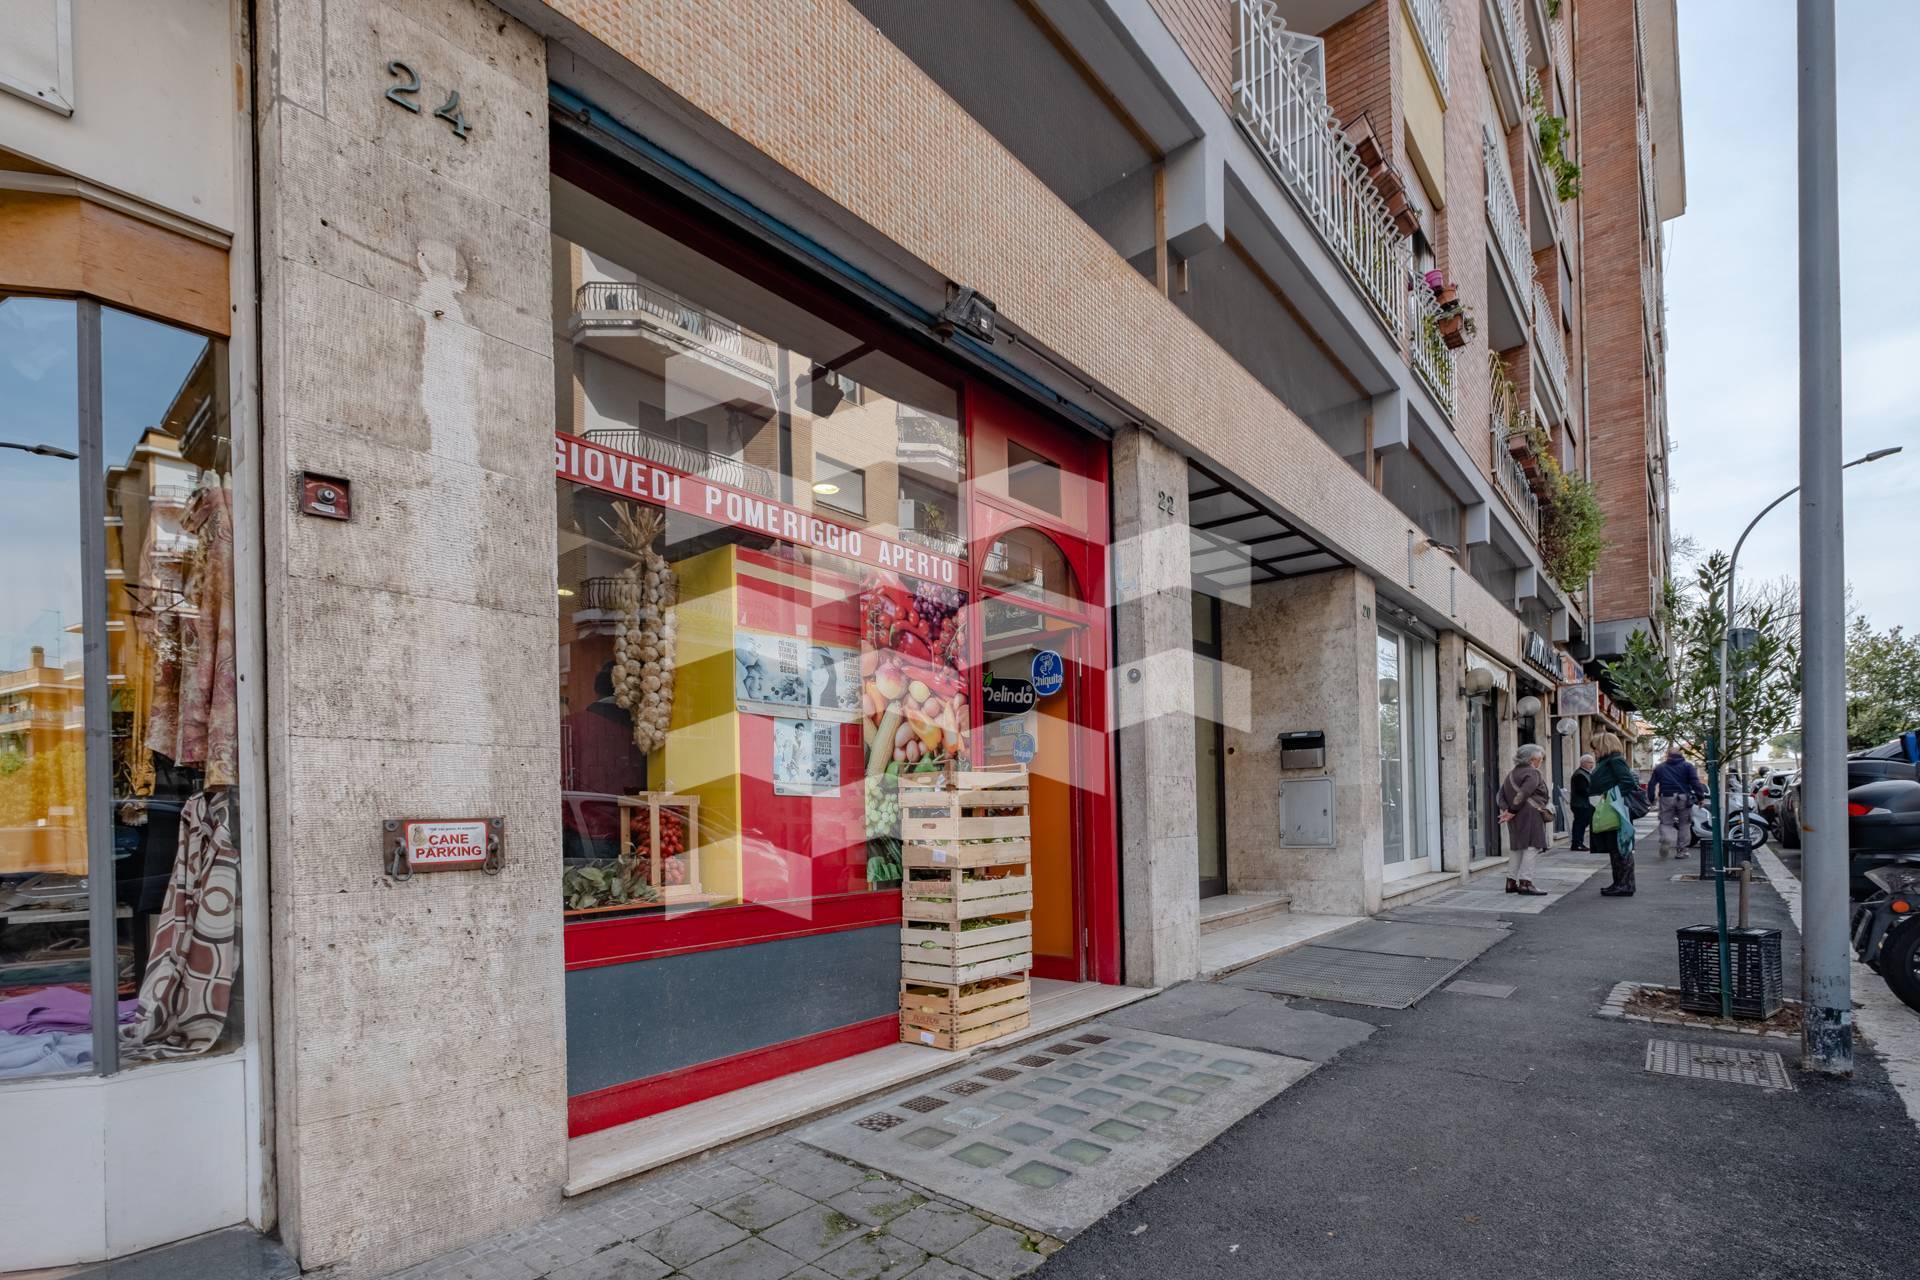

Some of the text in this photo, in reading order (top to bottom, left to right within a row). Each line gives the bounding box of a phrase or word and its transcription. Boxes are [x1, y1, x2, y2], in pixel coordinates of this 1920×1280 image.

[385, 60, 472, 141] 24
[555, 437, 953, 583] GIOVEDI POMERIGGIO APERTO
[1158, 491, 1175, 516] 22
[1362, 604, 1371, 620] 20
[1033, 674, 1063, 688] Chiquita
[814, 747, 832, 755] SECCA
[428, 833, 469, 846] CANE
[415, 845, 482, 859] PARKING
